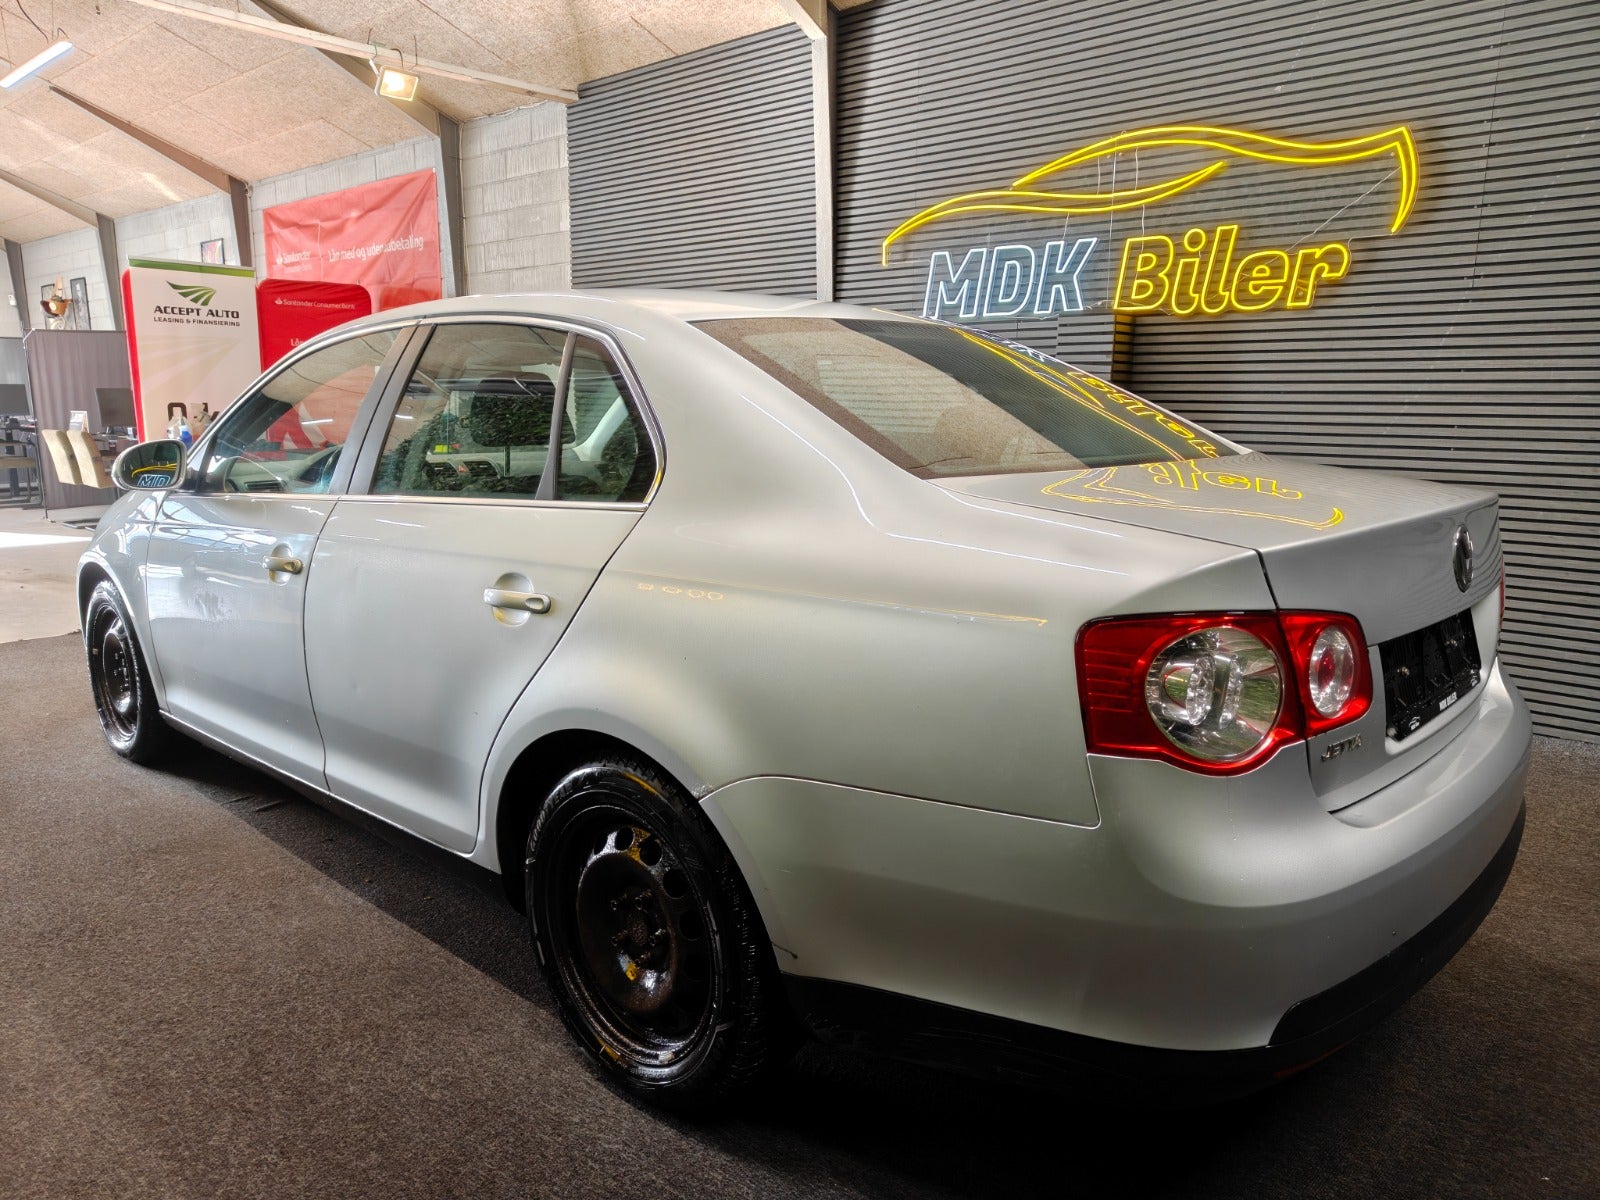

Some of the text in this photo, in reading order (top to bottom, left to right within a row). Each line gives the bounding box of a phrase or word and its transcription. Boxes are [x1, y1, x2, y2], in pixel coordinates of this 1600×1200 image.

[356, 246, 366, 261] og
[923, 225, 1350, 318] MDK Biler
[283, 298, 312, 307] Santander
[154, 305, 240, 319] ACCEPT AUTO
[192, 319, 240, 327] FINANSIERING
[1321, 734, 1362, 761] JETTA
